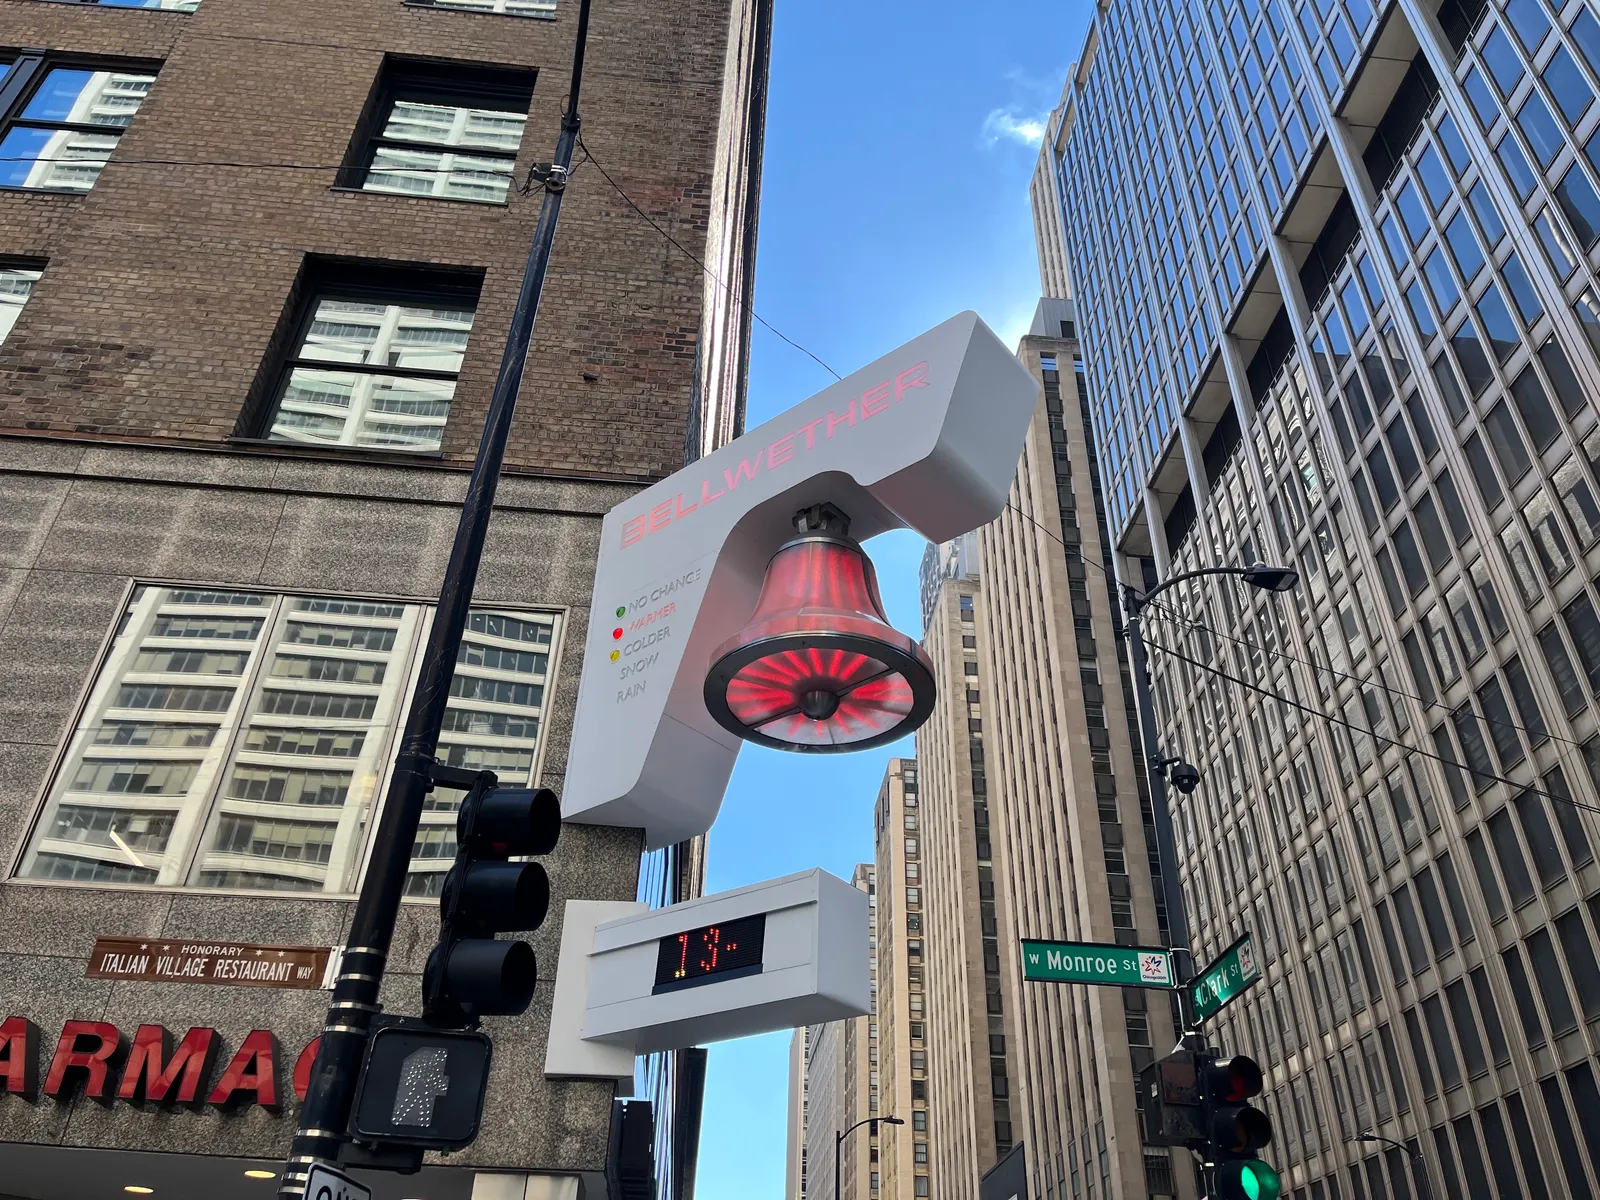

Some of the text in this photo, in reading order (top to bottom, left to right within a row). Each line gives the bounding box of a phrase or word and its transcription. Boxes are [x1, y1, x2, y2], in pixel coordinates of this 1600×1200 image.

[620, 359, 931, 550] BELLWETHER
[628, 568, 702, 615] NO CHANGE
[628, 602, 677, 632] WARMER
[623, 626, 671, 657] COLDER
[619, 652, 660, 680] SNOW
[616, 680, 647, 704] RAIN
[181, 944, 244, 957] HONORARY
[1046, 949, 1117, 974] Monroe
[1123, 959, 1137, 971] St
[99, 953, 313, 982] ITALIAN VILLAGE RESTAURANT WAY
[1200, 967, 1230, 1005] Clark
[1230, 962, 1239, 977] St
